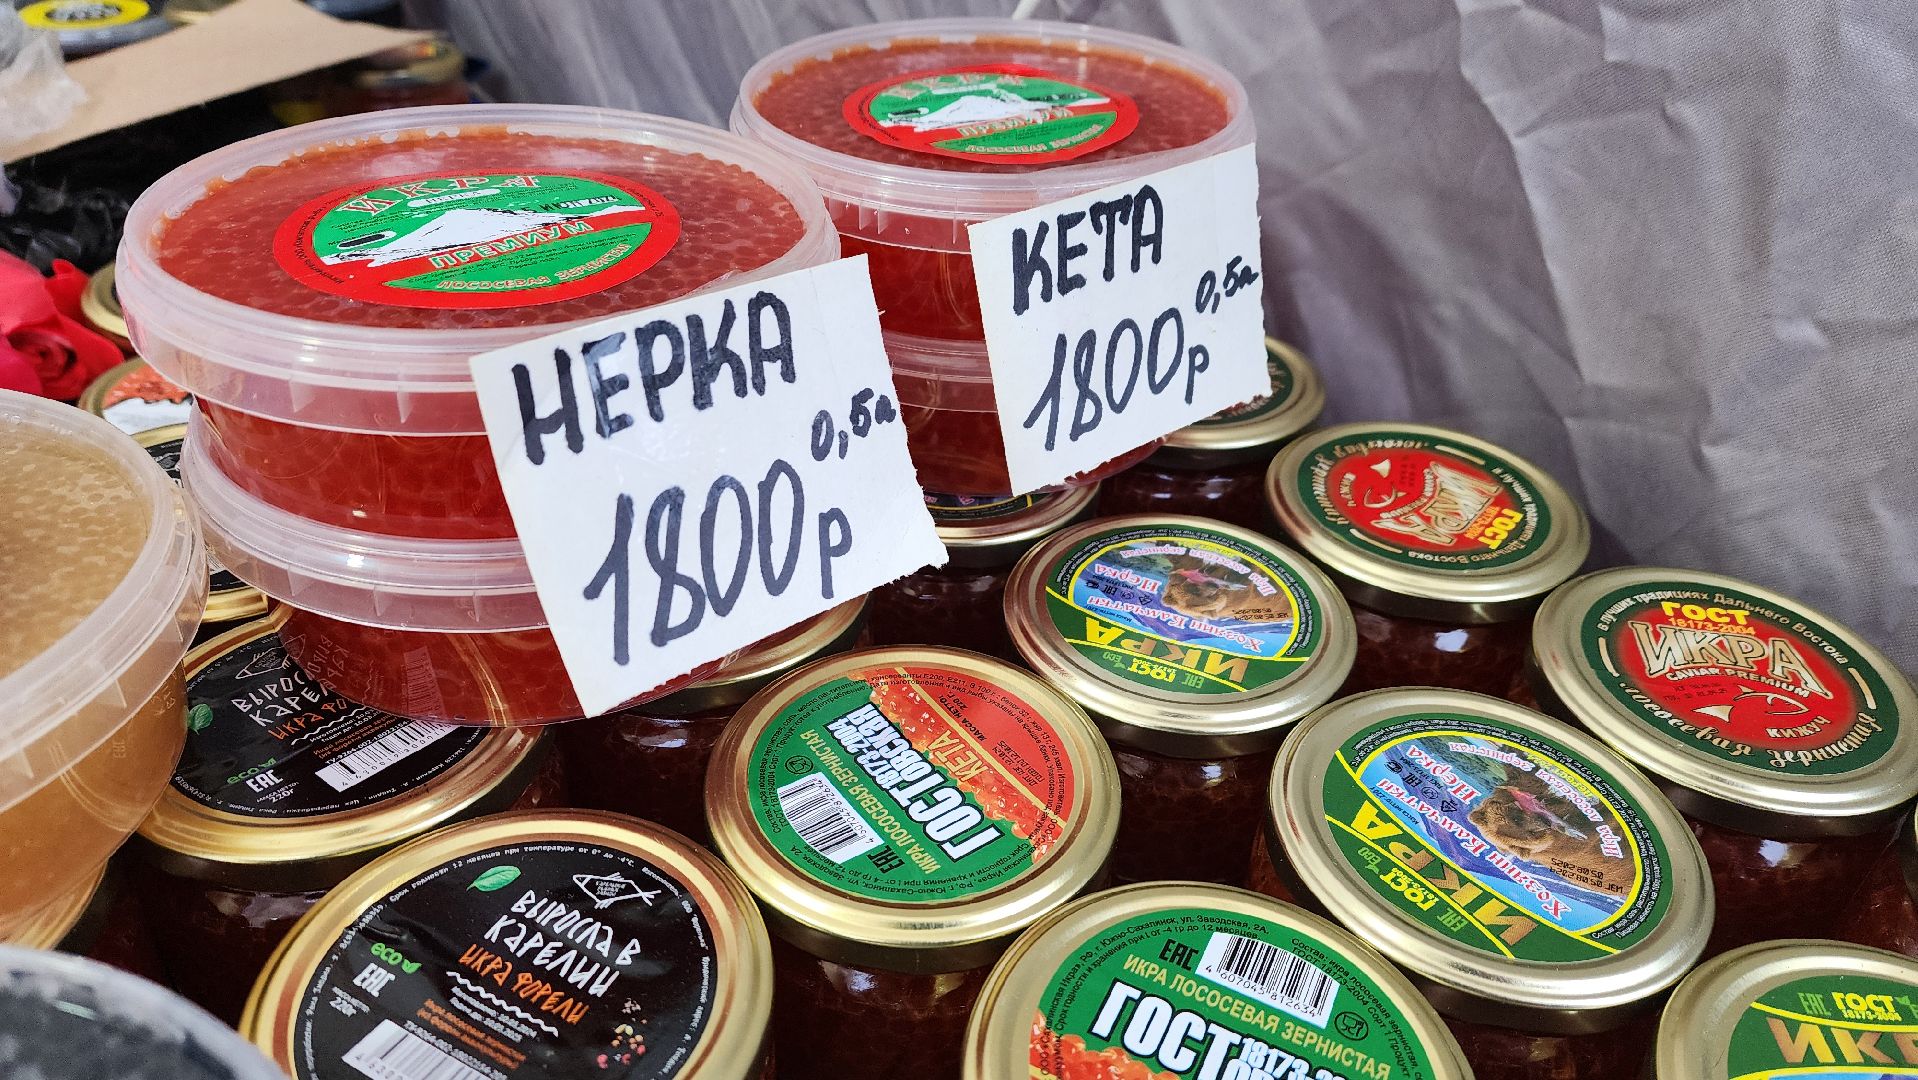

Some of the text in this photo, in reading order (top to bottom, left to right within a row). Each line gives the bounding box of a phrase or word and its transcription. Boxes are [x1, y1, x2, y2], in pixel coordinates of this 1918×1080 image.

[338, 175, 542, 216] ИКРА
[430, 221, 594, 269] ПРЕМИУМ
[1012, 184, 1163, 315] КЕТА
[437, 275, 552, 290] ЛОСОСЕВАЯ
[512, 291, 796, 465] НЕРКА
[1478, 509, 1524, 549] ГОСТ
[1095, 563, 1161, 594] Нерка
[1406, 550, 1469, 563] Востока
[1633, 590, 1709, 604] традициях
[1714, 593, 1790, 625] Дальнего
[1792, 623, 1849, 665] Востока
[1661, 601, 1750, 625] ГОСТ
[1668, 617, 1756, 635] 18173-2004
[1086, 617, 1249, 683] ИКРА
[1128, 662, 1176, 683] ГОСТ
[1628, 621, 1833, 699] ИКРА
[952, 697, 968, 710] 220
[1665, 668, 1720, 681] CAVIAR
[1725, 668, 1811, 698] PREMIUM
[268, 713, 324, 740] ИКРА
[962, 717, 987, 741] МАССА
[826, 718, 896, 791] 18173-2004
[927, 730, 989, 781] КЕТА
[1407, 745, 1482, 805] Нерка
[800, 729, 941, 875] ИКРА ЛОСОСЕВАЯ ЗЕРНИСТАЯ
[1448, 742, 1623, 858] Икра лососевая зернистая
[1351, 800, 1538, 945] ИКРА
[1376, 778, 1572, 921] Хозяин Камчатки
[1380, 868, 1436, 911] ГОСТ
[511, 889, 613, 958] ВЫРОСЛА
[1098, 914, 1179, 948] Южно-Сахалинск,
[1196, 915, 1251, 930] Заводская,
[371, 943, 403, 965] eco
[483, 914, 620, 997] КАРЕЛИИ
[1059, 970, 1090, 1008] годности
[1087, 939, 1130, 969] хранения
[1124, 931, 1146, 946] при
[1289, 936, 1333, 962] Состав:
[1326, 958, 1353, 978] икра
[458, 943, 513, 987] ИКРА
[512, 972, 590, 1025] ФОРЕЛИ
[1220, 971, 1316, 1018] 607045 812634
[1832, 992, 1896, 1012] ГОСТ
[1123, 953, 1392, 1080] ИКРА ЛОСОСЕВАЯ ЗЕРНИСТАЯ
